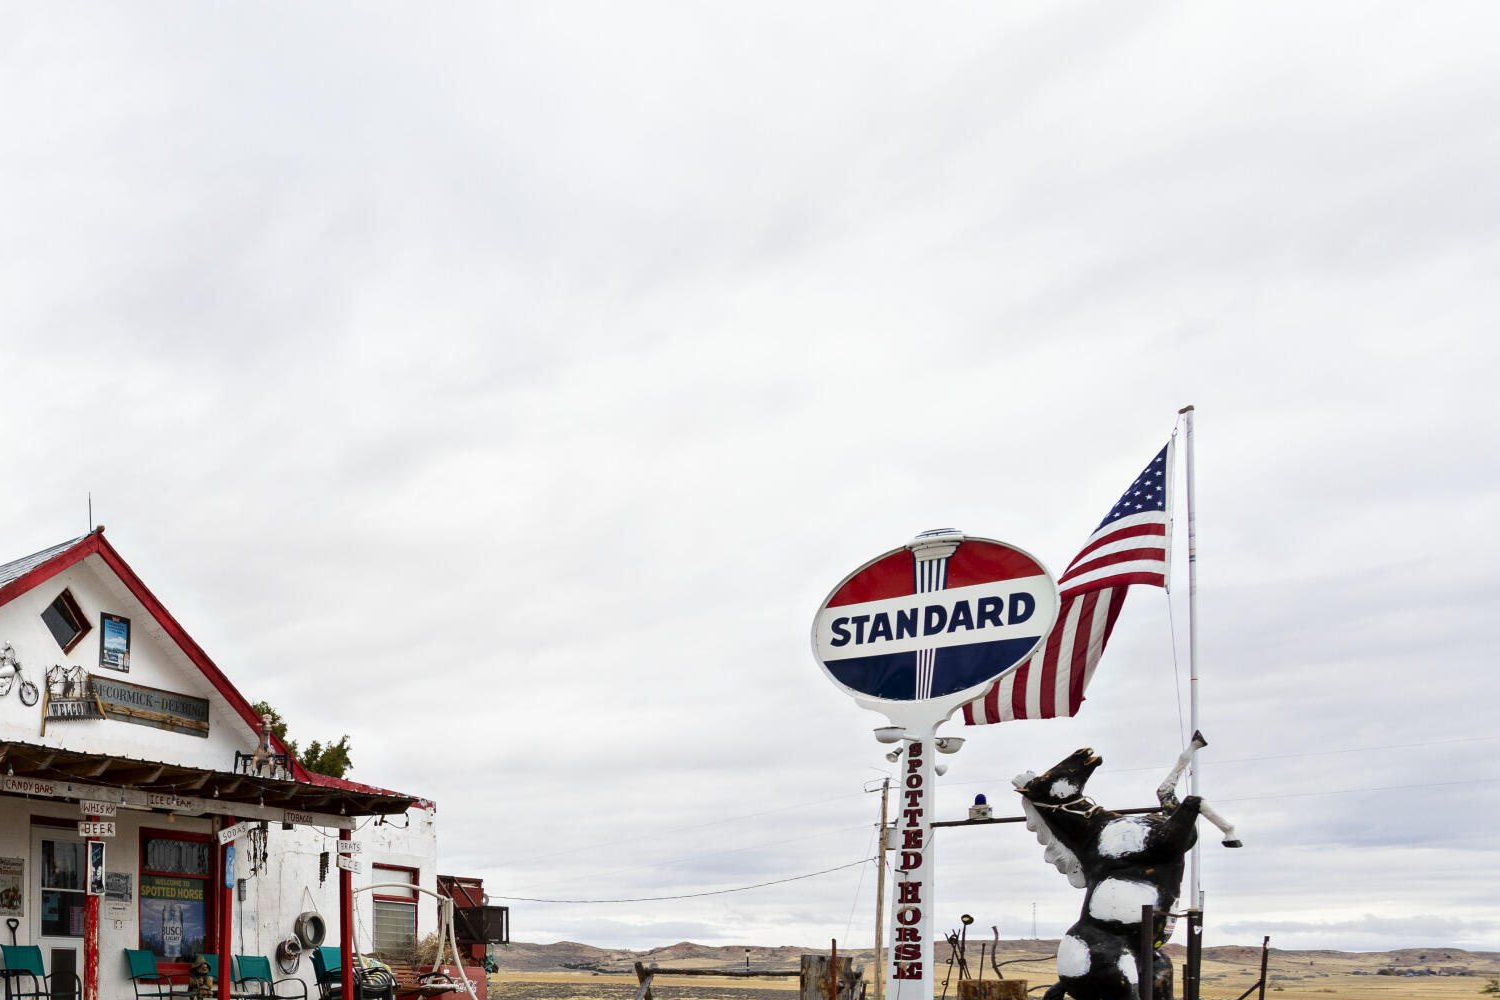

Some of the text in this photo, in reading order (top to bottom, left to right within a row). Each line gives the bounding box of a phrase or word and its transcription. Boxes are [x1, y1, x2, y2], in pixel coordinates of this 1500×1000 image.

[830, 591, 1036, 647] STANDARD
[5, 779, 54, 794] CANDY BARS
[150, 794, 192, 808] ICE CEAM
[900, 742, 922, 870] SPOTTED
[83, 803, 116, 814] WHISKY
[286, 812, 313, 824] TOBACCO
[85, 823, 113, 834] BEER
[222, 824, 246, 842] SODAS
[342, 858, 359, 871] ICE
[155, 878, 182, 887] WELCOME
[141, 886, 204, 900] SPOTTED HORSE
[893, 882, 922, 980] HORSE
